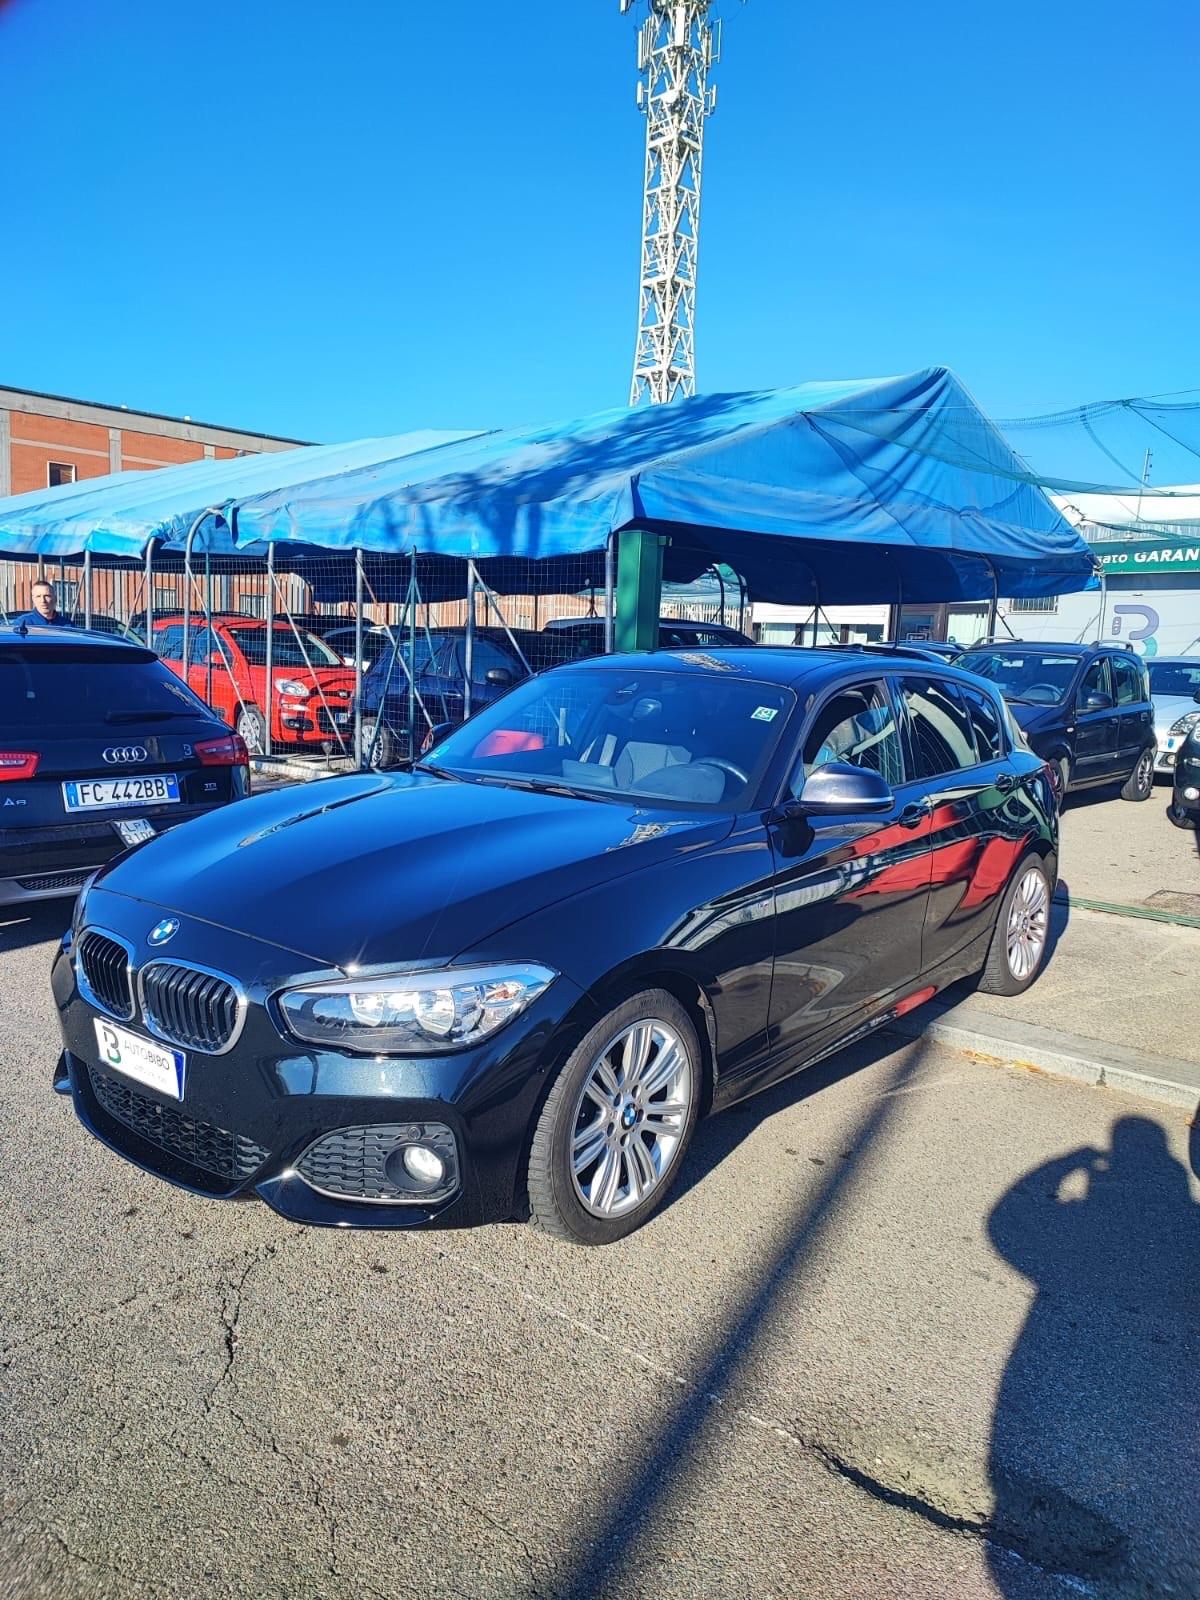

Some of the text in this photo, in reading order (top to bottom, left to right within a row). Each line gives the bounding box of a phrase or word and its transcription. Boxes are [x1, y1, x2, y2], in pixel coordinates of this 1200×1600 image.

[1133, 548, 1200, 563] GARAN
[80, 778, 165, 803] FC 442BB
